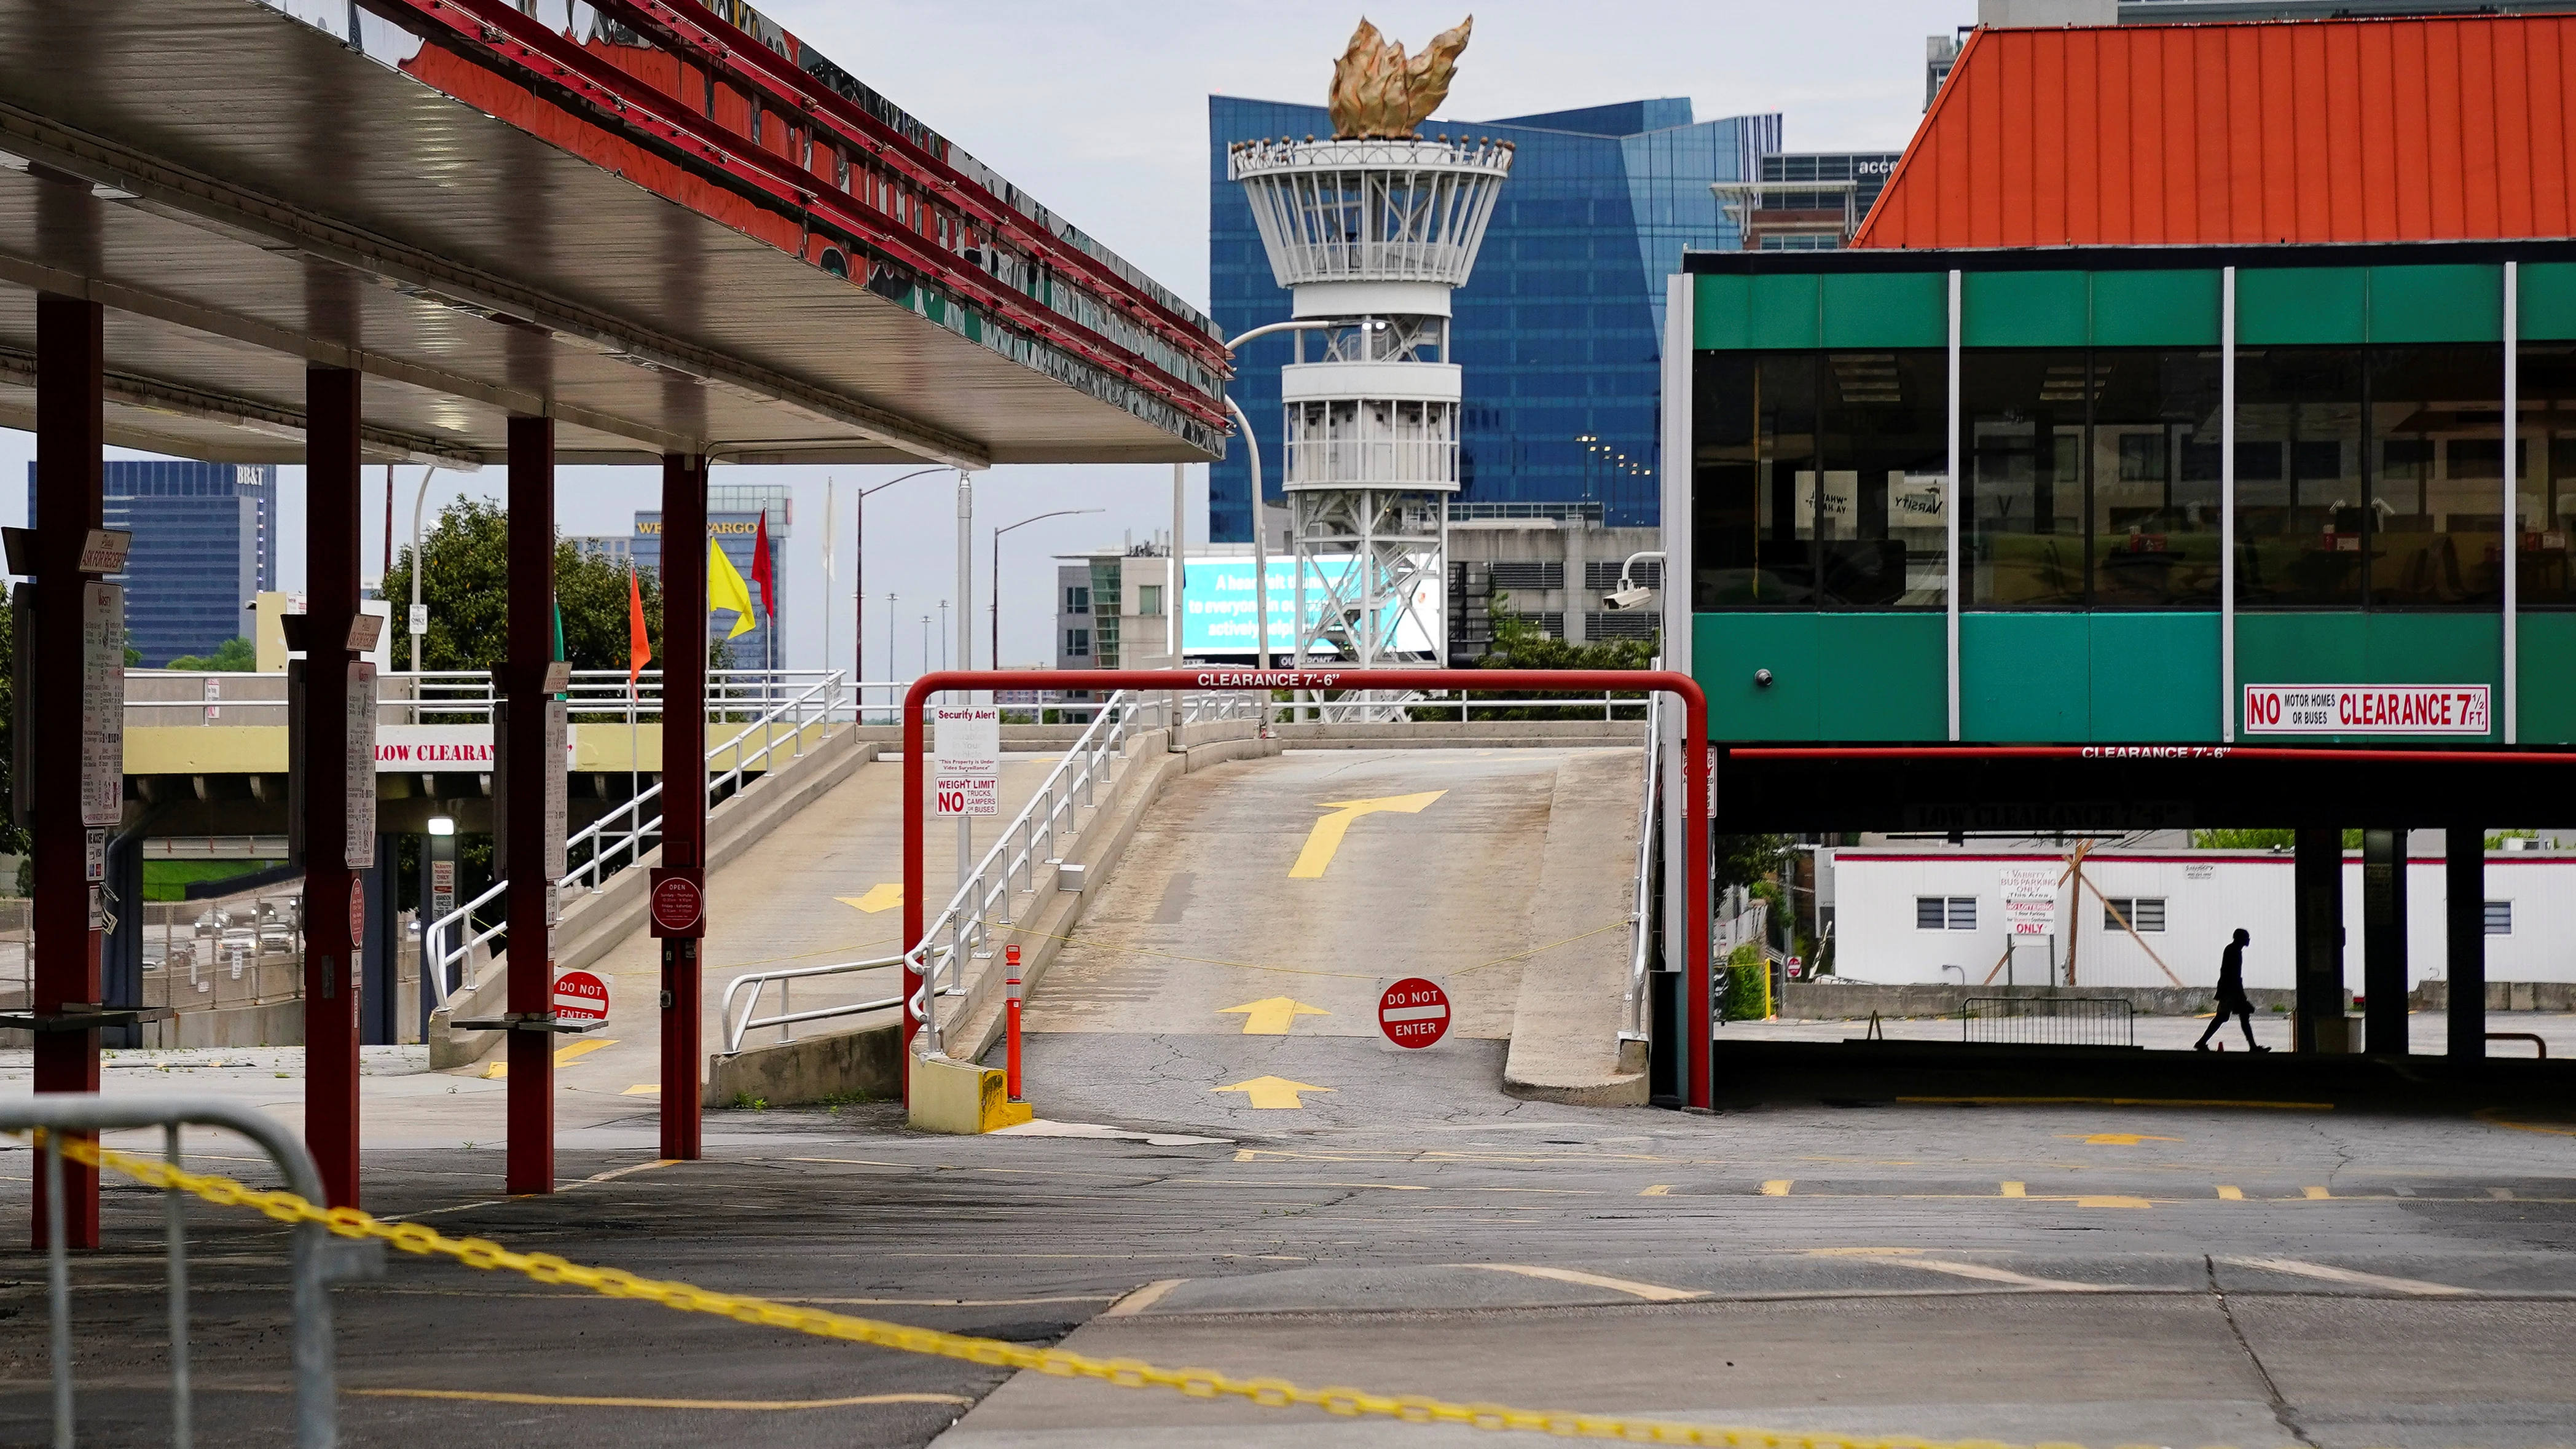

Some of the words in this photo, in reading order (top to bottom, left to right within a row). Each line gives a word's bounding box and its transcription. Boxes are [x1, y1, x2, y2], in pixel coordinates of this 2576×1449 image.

[237, 466, 264, 486] BB&T
[708, 522, 758, 534] ARGO
[1215, 574, 1227, 590] A
[1228, 574, 1286, 590] hearelt
[1188, 599, 1204, 614] to
[1204, 600, 1258, 616] everyon
[1266, 596, 1279, 612] in
[1208, 619, 1260, 639] actively
[1198, 673, 1300, 686] CLEARANCE
[1303, 673, 1340, 686] 7'-6"
[2284, 694, 2309, 707] MOTOR
[2311, 694, 2336, 707] HOMES
[938, 710, 973, 721] Security
[975, 710, 995, 719] Alert
[2250, 693, 2281, 725] NO
[2339, 694, 2451, 726] CLEARANCE
[2457, 694, 2471, 726] 7
[2292, 712, 2303, 724] OR
[2304, 712, 2328, 724] BUSES
[375, 745, 411, 761] LOW
[417, 745, 494, 761] CLEARA
[2081, 747, 2188, 758] CLEARANCE
[2193, 747, 2232, 758] 7'-6"
[938, 780, 971, 789] WEIGHT
[973, 780, 995, 789] LIMIT
[938, 791, 964, 812] NO
[2016, 924, 2044, 933] ONLY
[560, 981, 575, 992] DO
[579, 984, 602, 996] NOT
[1388, 993, 1405, 1005] DO
[1411, 990, 1438, 1003] NOT
[560, 1009, 594, 1019] ENTER
[1395, 1023, 1436, 1037] ENTER
